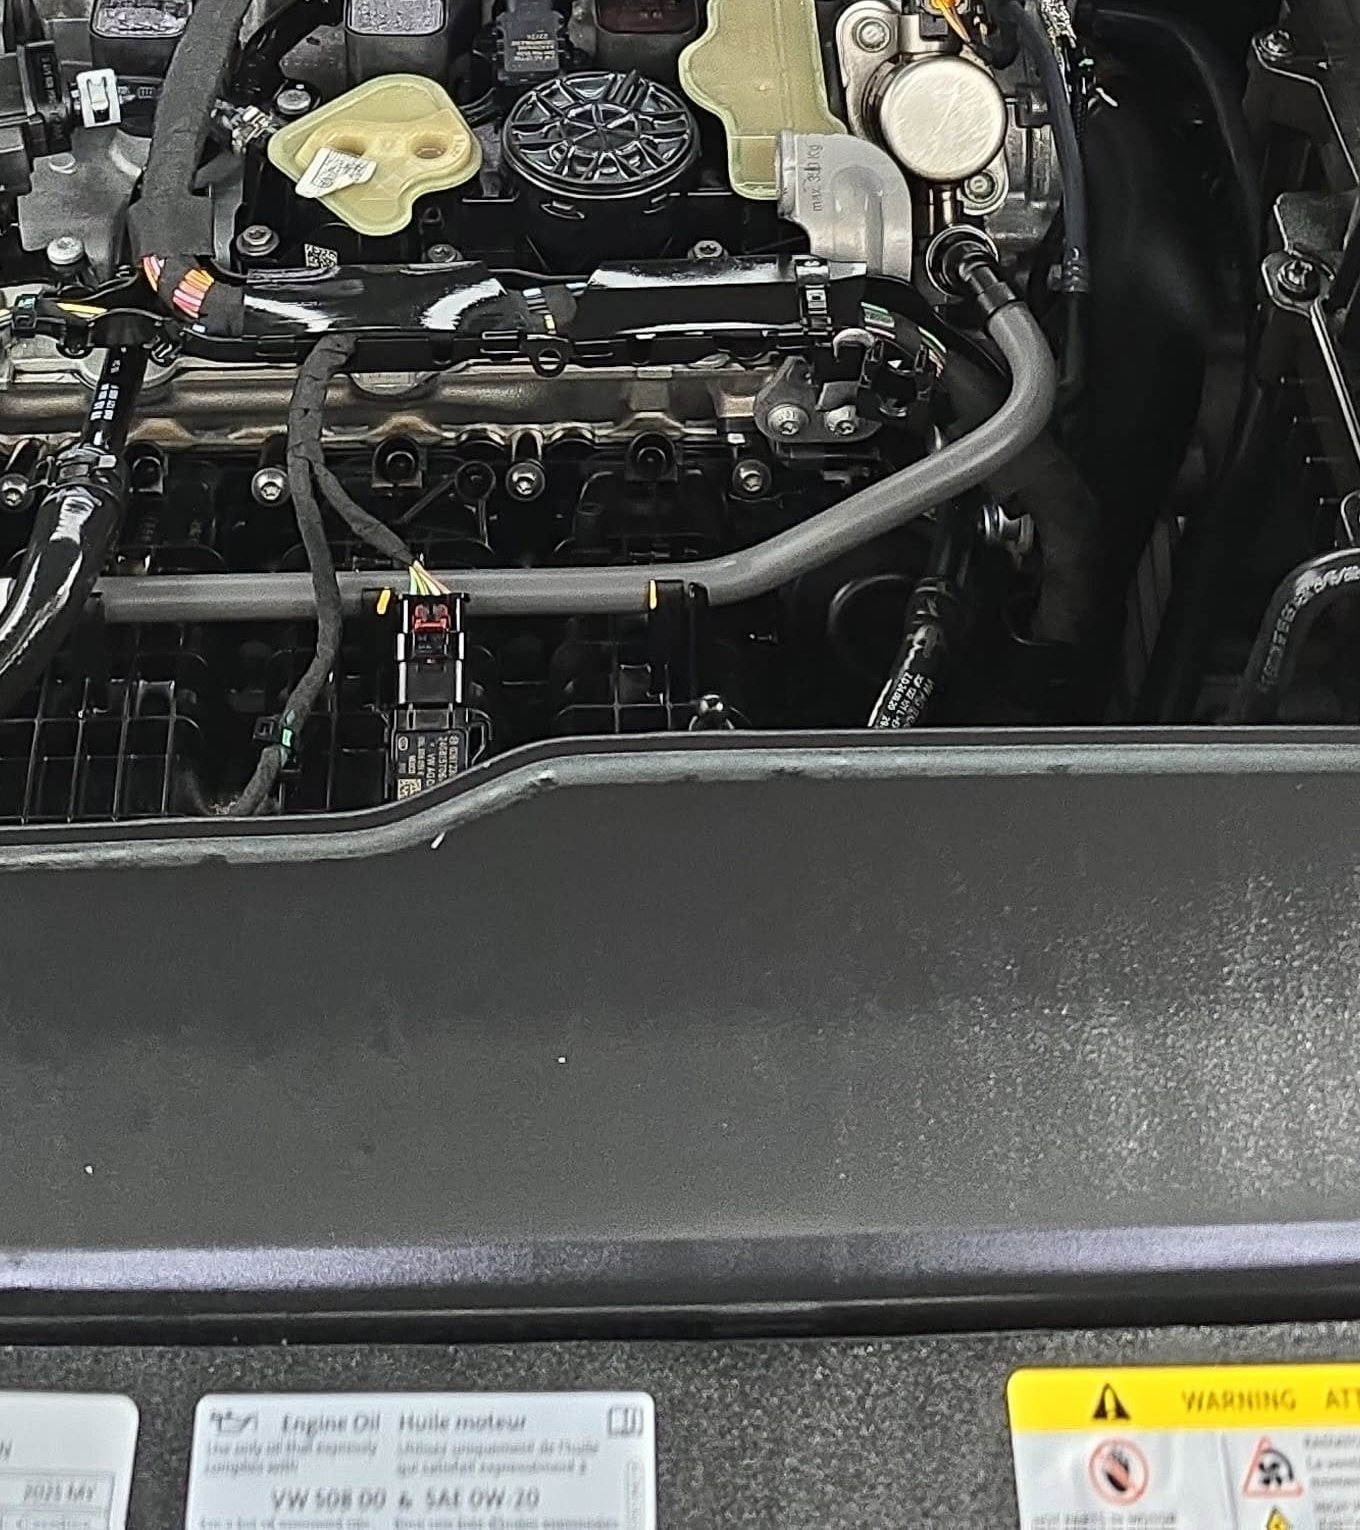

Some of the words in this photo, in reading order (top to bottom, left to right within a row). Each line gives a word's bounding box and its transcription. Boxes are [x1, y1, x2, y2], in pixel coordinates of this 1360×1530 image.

[1182, 1388, 1297, 1413] WARNING
[281, 1413, 348, 1438] Engine
[352, 1412, 381, 1432] Oil
[398, 1412, 450, 1432] Huile
[454, 1414, 527, 1433] moteur
[270, 1486, 309, 1512] VW
[357, 1487, 387, 1512] 00
